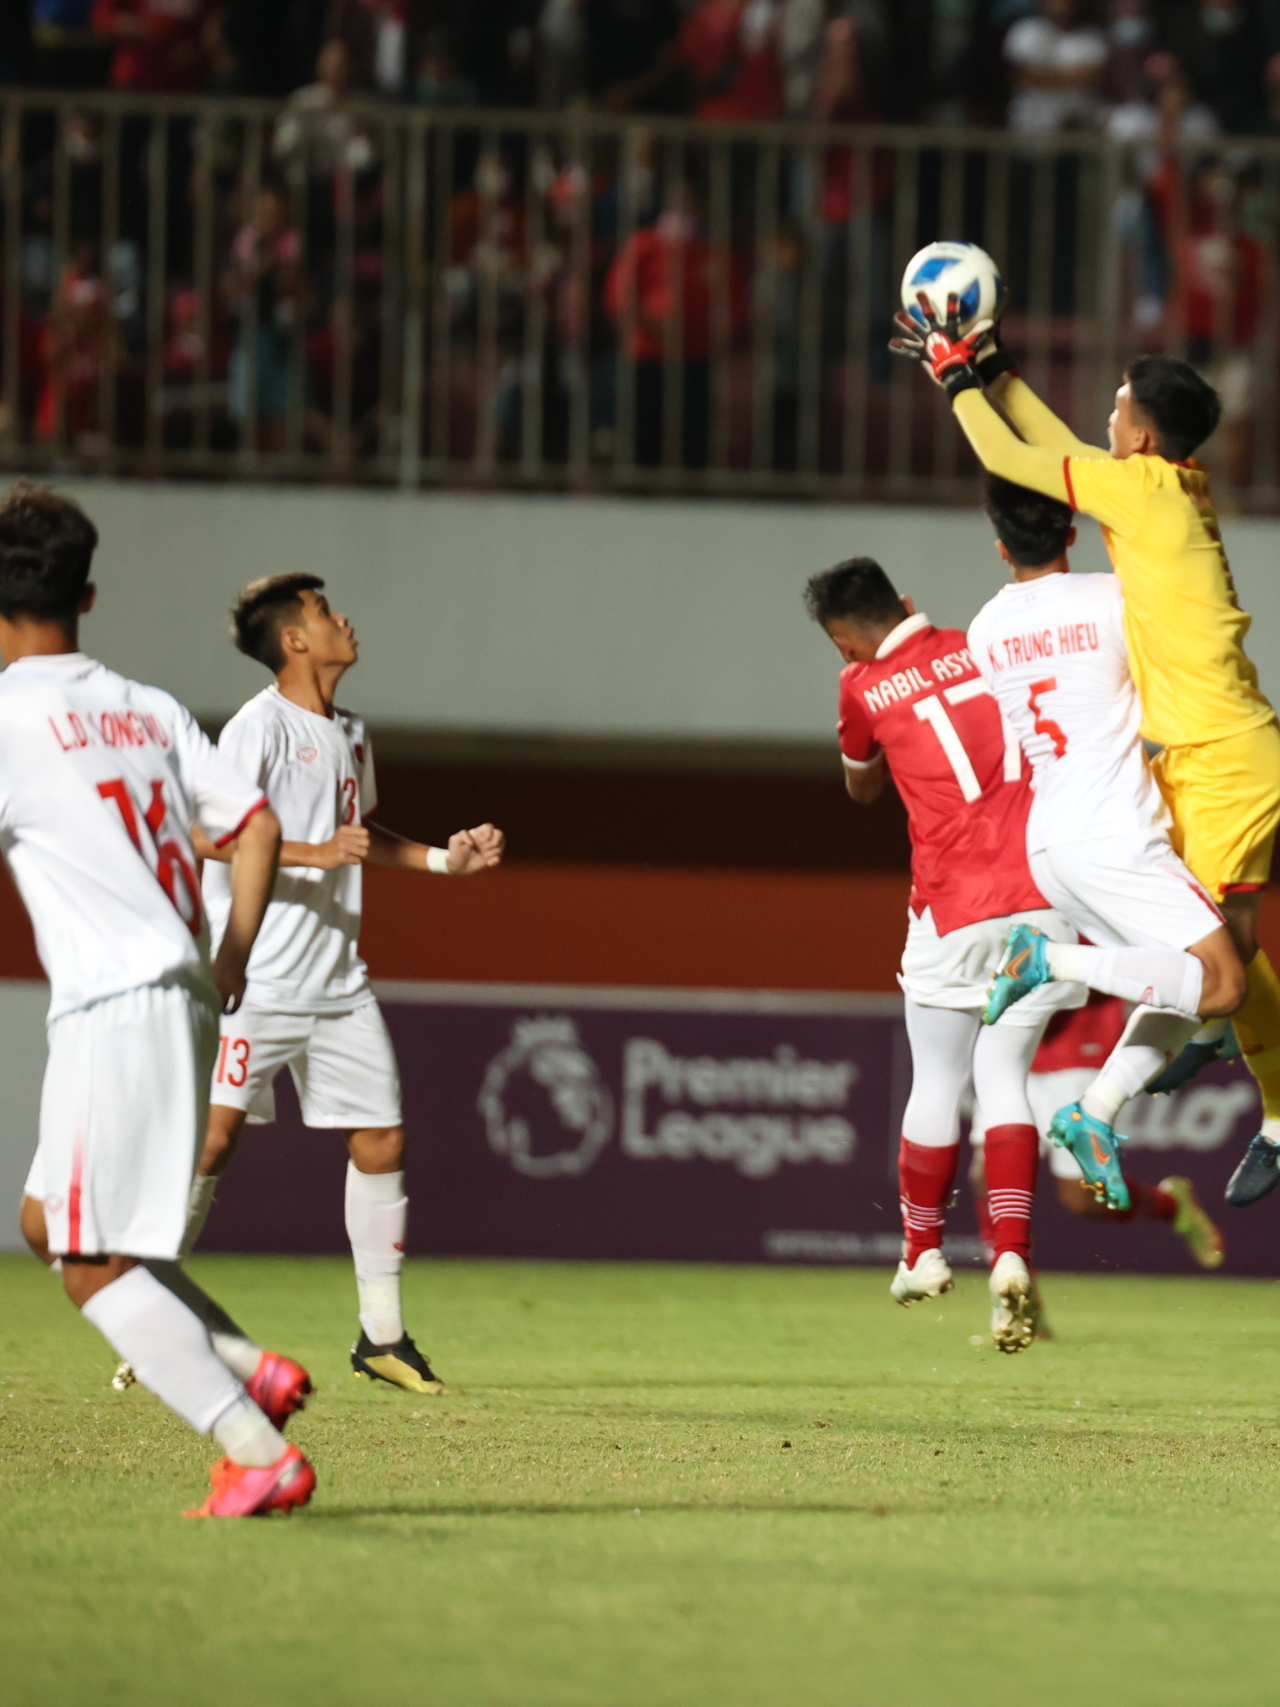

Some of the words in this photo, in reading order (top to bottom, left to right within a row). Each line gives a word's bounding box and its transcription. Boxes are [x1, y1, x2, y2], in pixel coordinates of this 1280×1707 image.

[863, 667, 934, 713] NABIL
[931, 647, 977, 683] ASY
[987, 643, 1004, 672] K.
[1003, 629, 1054, 667] TRUNG
[1058, 621, 1100, 655] HIEU
[912, 676, 1022, 804] 17
[1027, 676, 1069, 761] 5
[216, 1035, 252, 1088] 13
[622, 1036, 858, 1107] Premier
[621, 1107, 858, 1179] League
